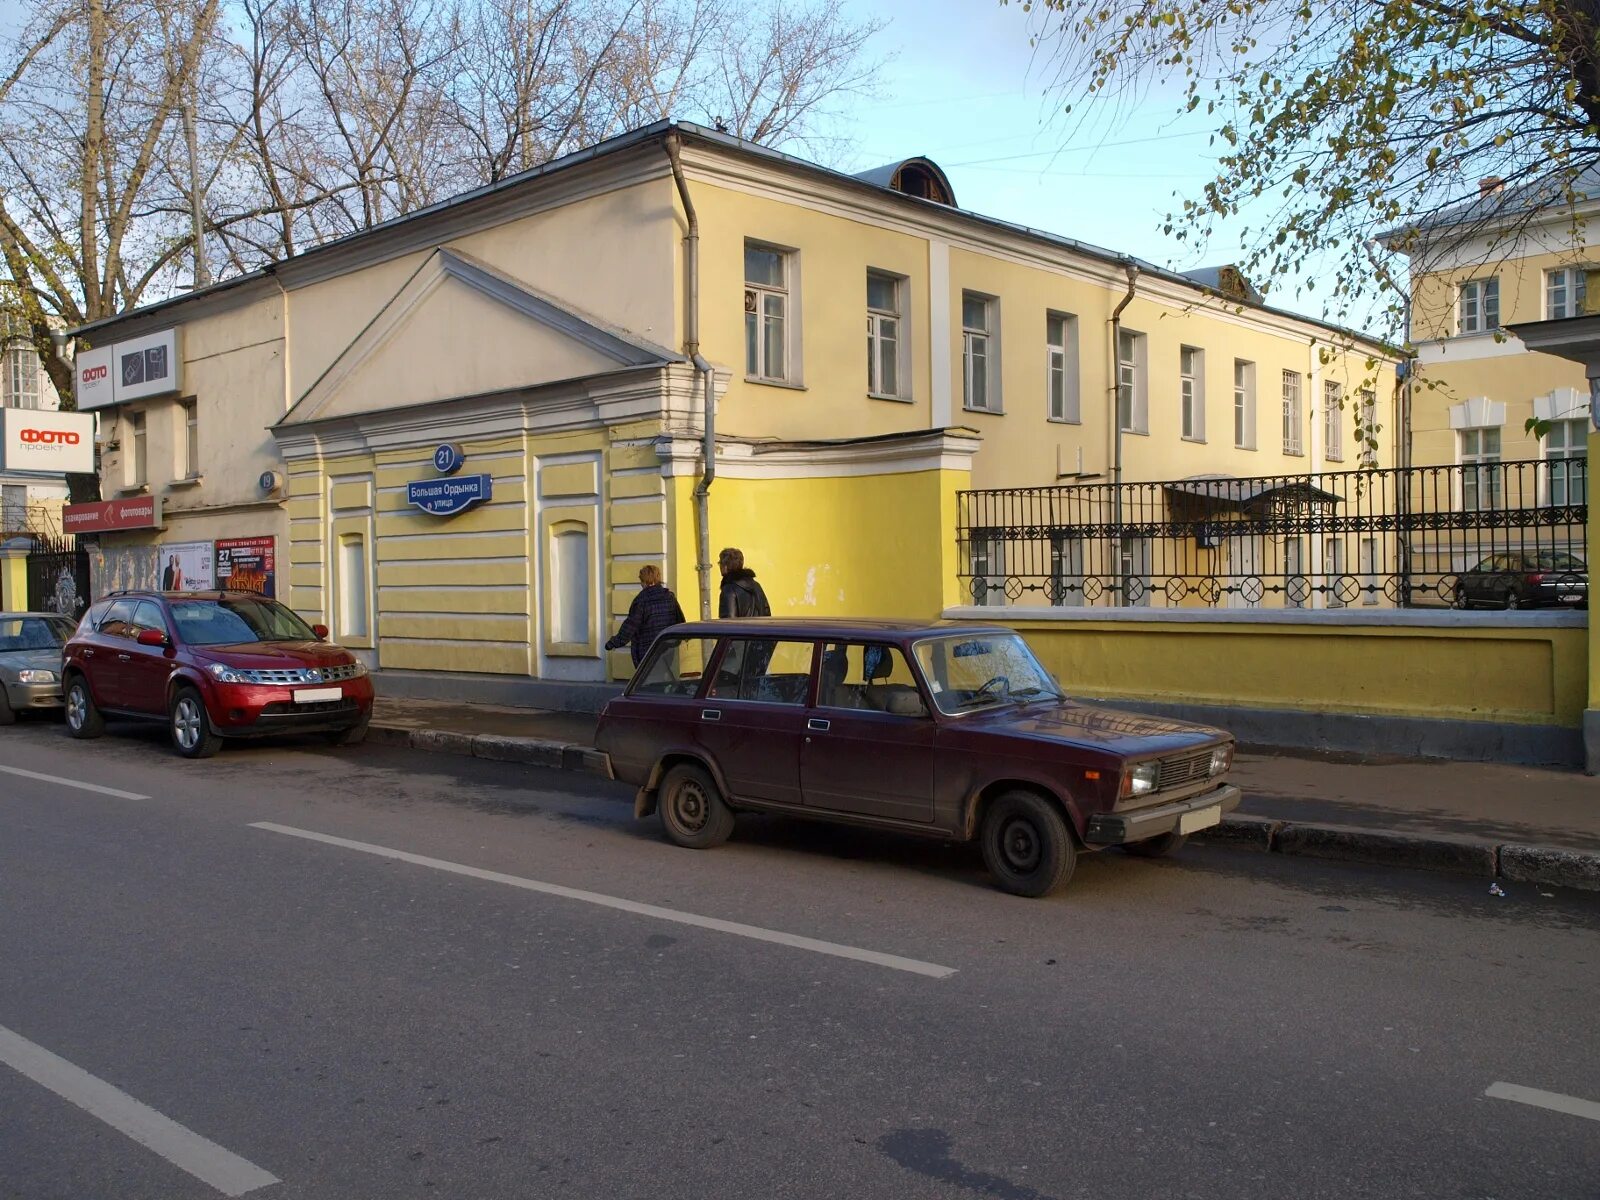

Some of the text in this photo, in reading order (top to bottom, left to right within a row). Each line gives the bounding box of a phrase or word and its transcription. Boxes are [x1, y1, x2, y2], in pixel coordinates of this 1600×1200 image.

[82, 365, 107, 382] ФОТО
[20, 429, 80, 444] ФОТО
[20, 443, 63, 452] проект
[438, 450, 450, 464] 21
[411, 483, 478, 497] Большая Ордынка
[434, 499, 453, 509] улица
[65, 506, 152, 524] сканирование фототовары
[219, 550, 229, 561] 27
